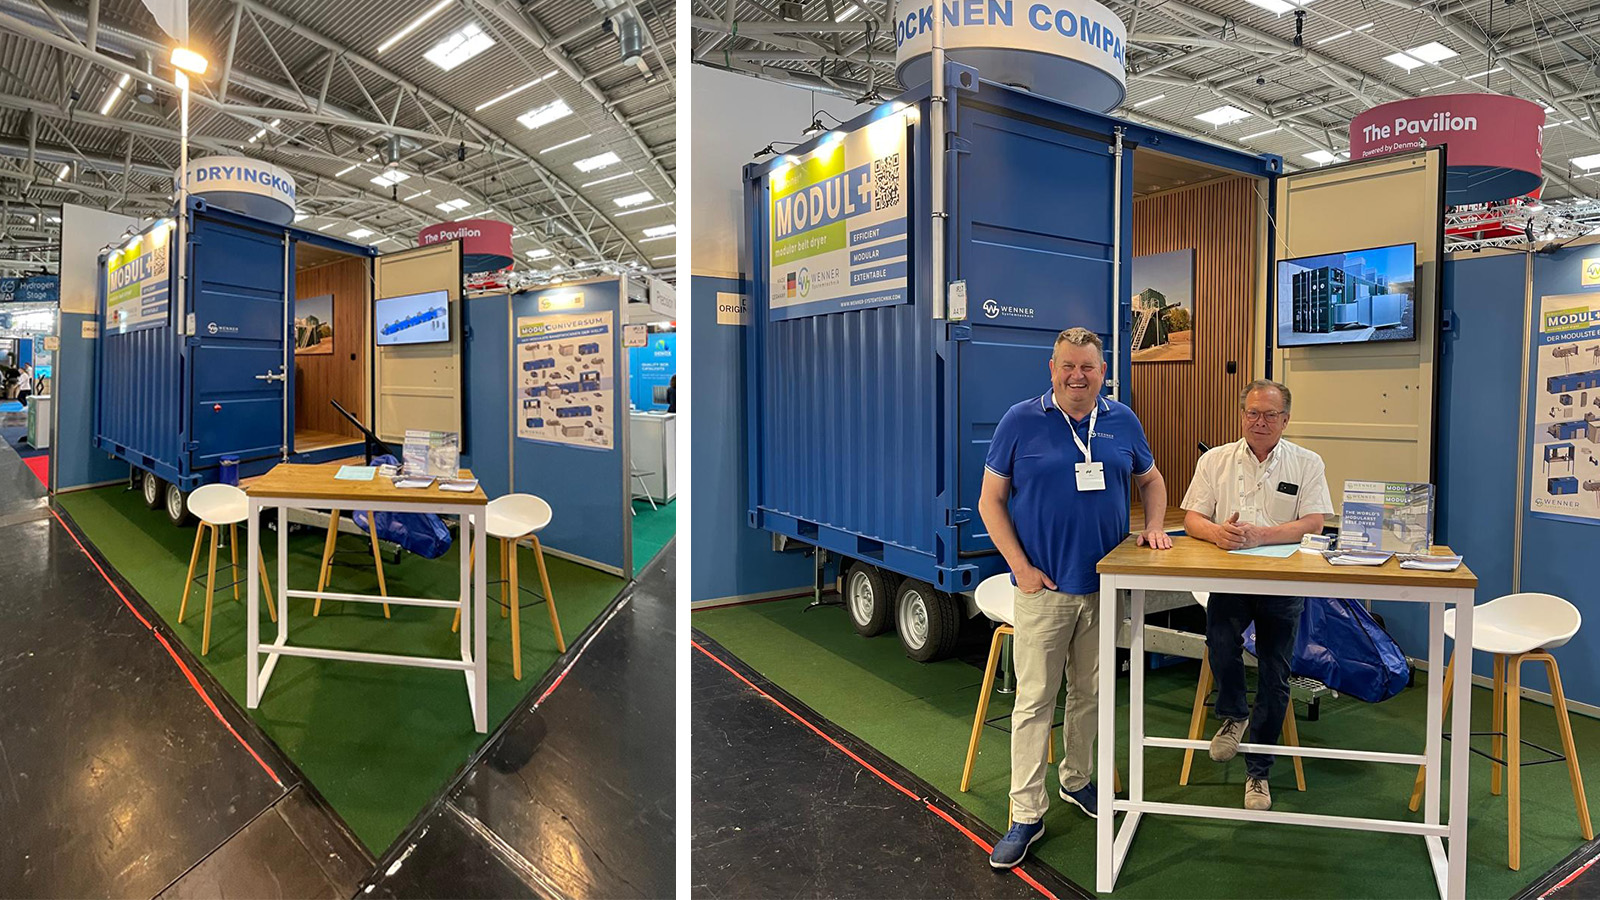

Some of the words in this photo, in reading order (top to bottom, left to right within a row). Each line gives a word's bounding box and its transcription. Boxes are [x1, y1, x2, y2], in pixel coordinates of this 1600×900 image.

[1363, 123, 1391, 144] The
[1394, 111, 1478, 137] Pavilion
[1362, 144, 1385, 158] Powered
[1385, 143, 1393, 153] by
[1393, 137, 1428, 151] Denmar
[776, 172, 871, 238] MODUL+
[424, 233, 439, 244] The
[440, 227, 481, 240] Pavilion
[853, 228, 880, 242] EFFICIENT
[775, 242, 797, 258] modular
[797, 238, 810, 251] belt
[810, 235, 827, 253] dryer
[853, 249, 880, 262] MODULAR
[811, 268, 840, 282] WENNER
[854, 268, 887, 282] EXTENTABLE
[20, 281, 55, 292] Hydrogen
[26, 291, 47, 301] Stage
[1000, 305, 1034, 315] WENNER
[1560, 329, 1597, 341] MODULSTE
[1544, 498, 1580, 508] WENNER
